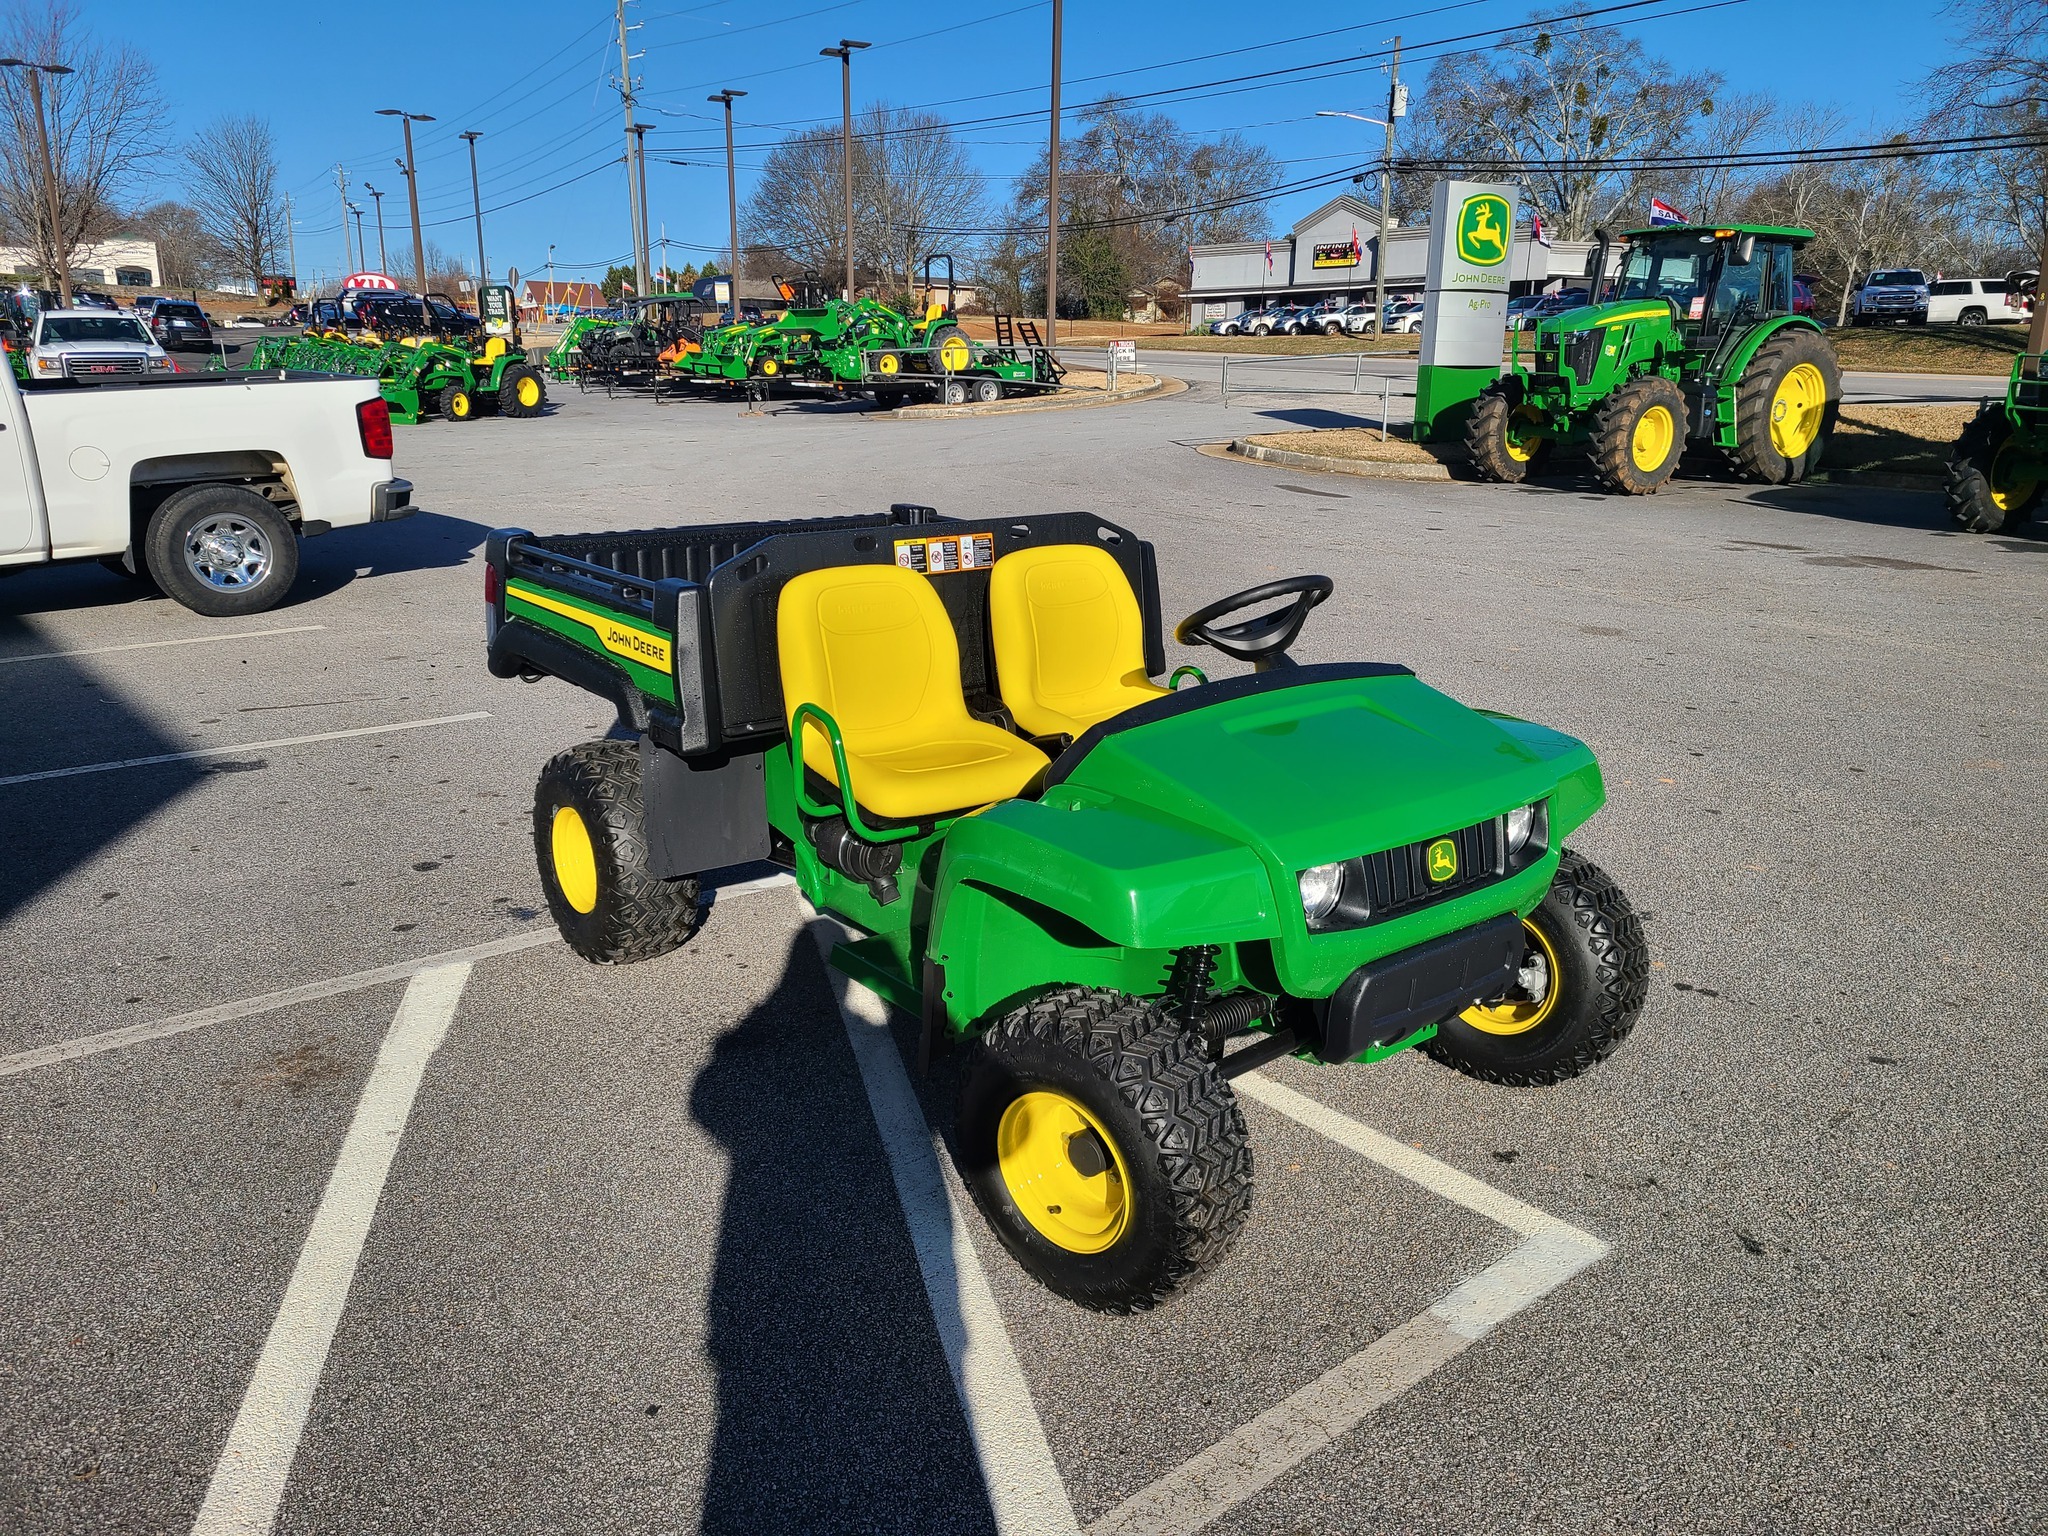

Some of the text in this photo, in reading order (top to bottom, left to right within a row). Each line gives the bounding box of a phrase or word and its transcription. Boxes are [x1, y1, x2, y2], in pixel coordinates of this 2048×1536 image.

[352, 278, 389, 289] KIA
[1452, 272, 1506, 285] JOHN DEERE
[1467, 298, 1491, 311] Ag-Pro
[90, 365, 122, 373] GMC
[606, 626, 665, 662] JOHN DEERE
